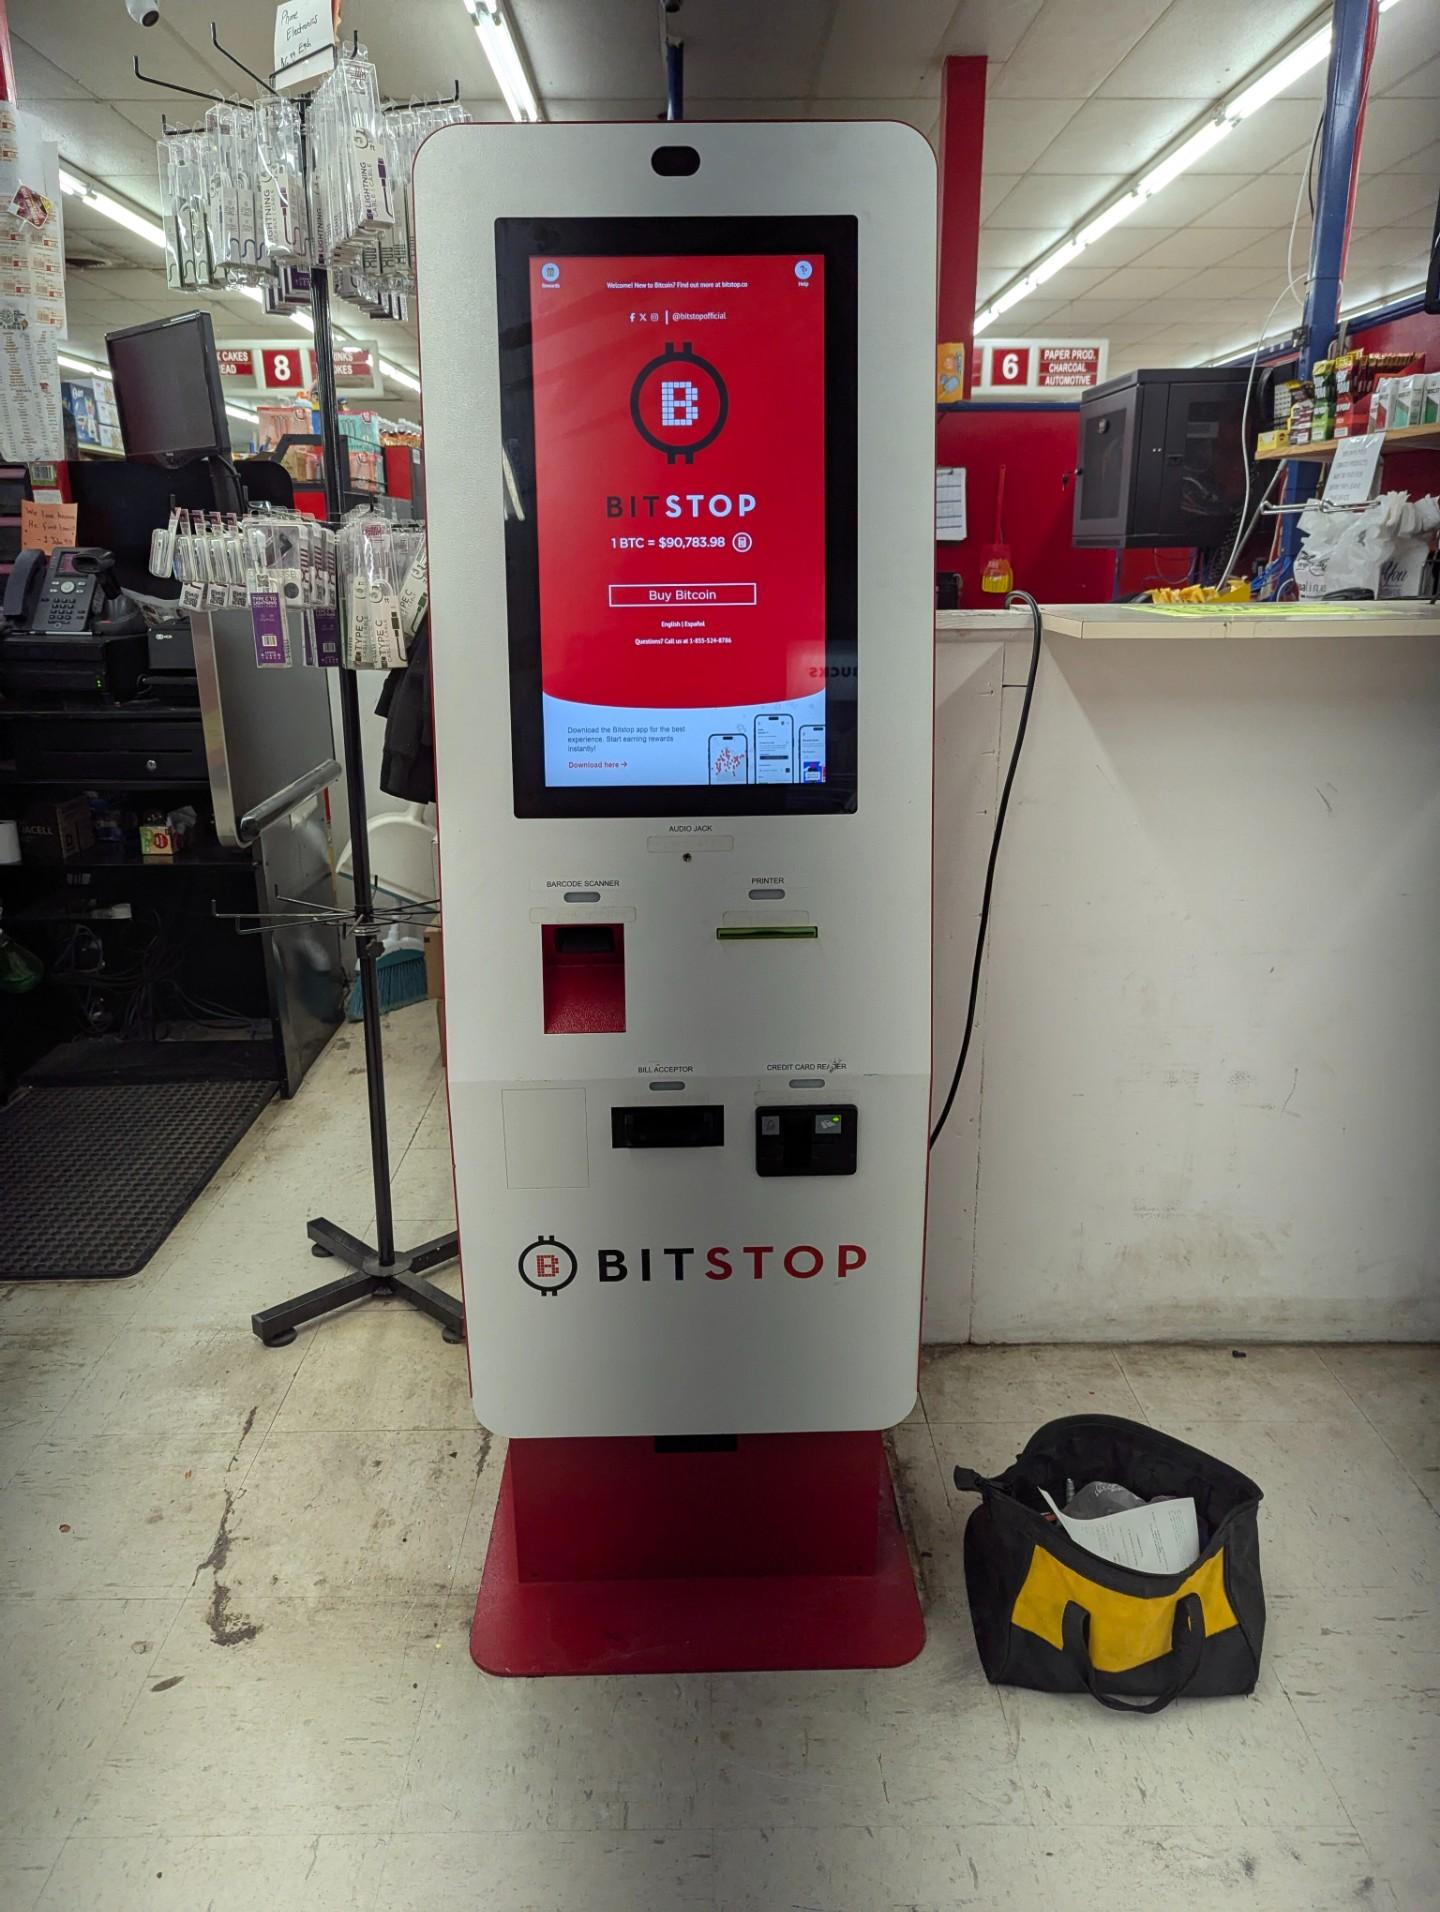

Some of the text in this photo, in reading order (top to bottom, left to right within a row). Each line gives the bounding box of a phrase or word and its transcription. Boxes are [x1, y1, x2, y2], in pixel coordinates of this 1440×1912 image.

[360, 161, 372, 209] LIGHTNING
[263, 189, 274, 243] IGHTNING
[722, 281, 748, 289] bitstop.co
[672, 312, 727, 321] @bitstopofficial
[222, 351, 249, 362] CAKES
[334, 351, 353, 362] INKS
[1043, 349, 1096, 360] PAPER PROD.
[219, 364, 237, 375] EAD
[273, 354, 291, 381] 8
[334, 364, 353, 375] OKES
[1002, 353, 1019, 380] 6
[1048, 363, 1087, 373] CHARCOAL
[1044, 375, 1091, 386] AUTOMOTIVE
[606, 494, 757, 519] BITSTOP
[611, 538, 616, 549] 1
[620, 537, 645, 549] BTC
[659, 536, 726, 549] $90,783.98
[649, 589, 717, 602] Buy Bitcoin
[355, 615, 364, 650] TYPE C
[375, 619, 386, 657] TYPE C
[567, 726, 600, 734] Download
[612, 726, 635, 734] Bitstop
[567, 736, 604, 744] experience.
[567, 745, 596, 753] instantly!
[568, 761, 619, 769] Download here
[751, 877, 784, 885] PRINTER
[597, 1244, 867, 1282] BITSTOP
